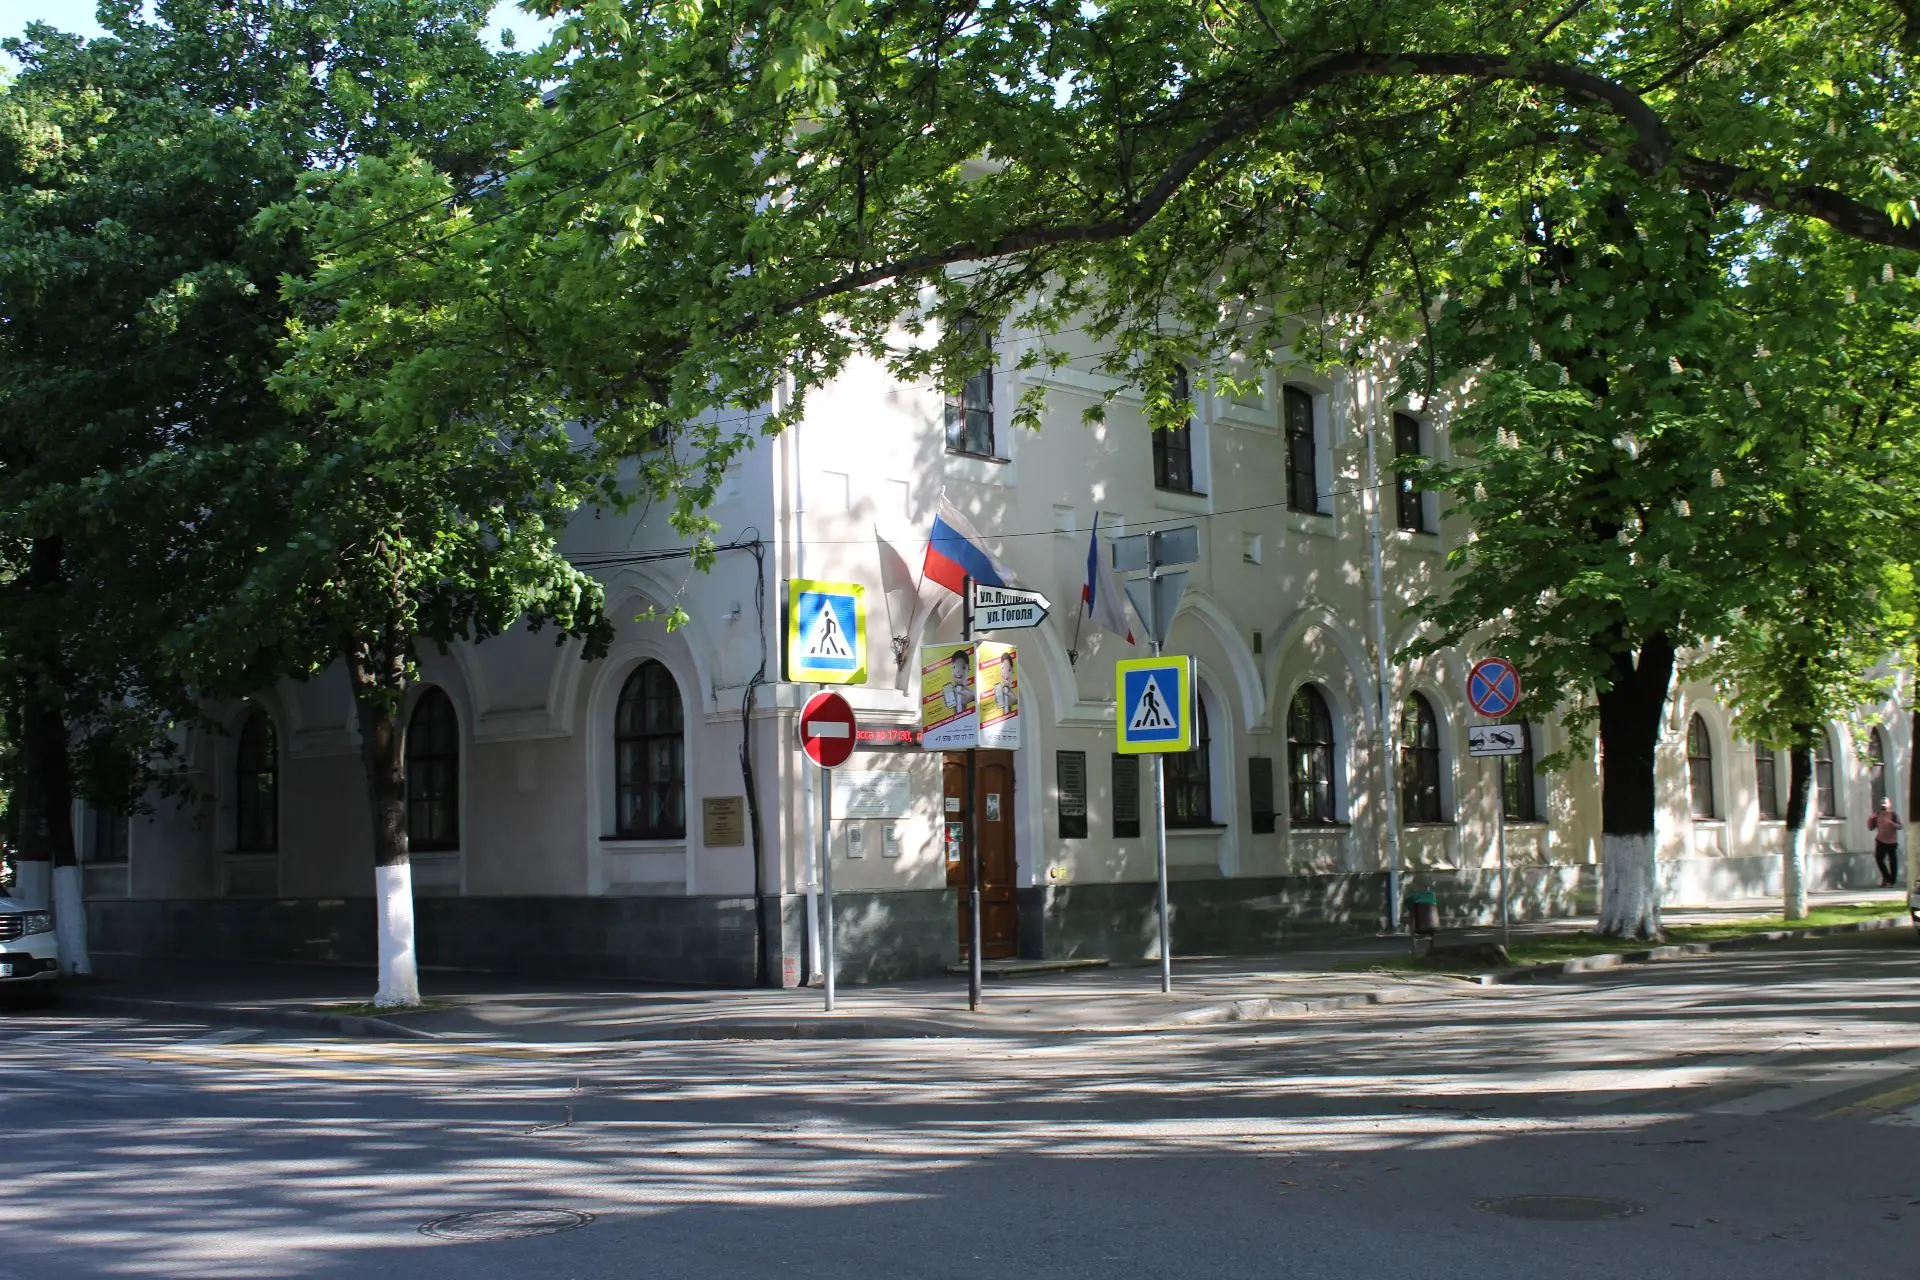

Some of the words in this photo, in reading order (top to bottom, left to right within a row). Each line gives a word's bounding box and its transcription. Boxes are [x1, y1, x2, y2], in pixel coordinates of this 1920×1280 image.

[980, 591, 994, 603] ул.
[987, 610, 1000, 624] ул.
[1002, 608, 1032, 622] Гоголя
[856, 730, 874, 740] асса
